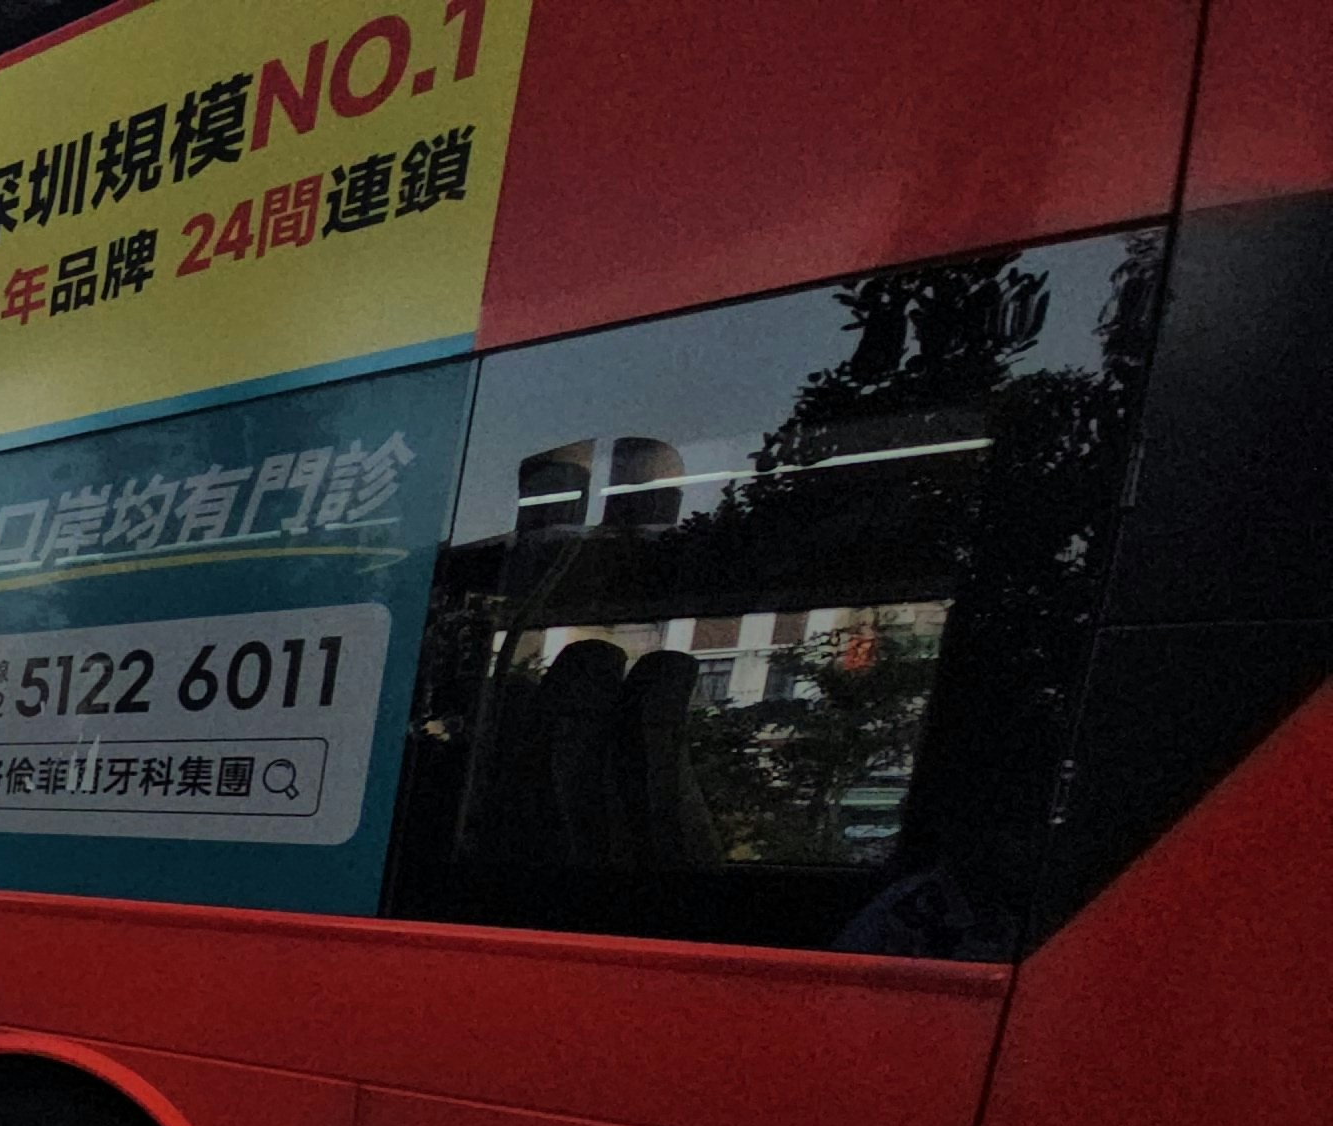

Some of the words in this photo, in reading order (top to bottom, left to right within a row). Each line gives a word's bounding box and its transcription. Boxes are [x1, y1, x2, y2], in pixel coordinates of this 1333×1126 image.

[175, 124, 476, 278] 24間連鎖
[15, 648, 154, 719] 5122
[178, 635, 343, 712] 6011
